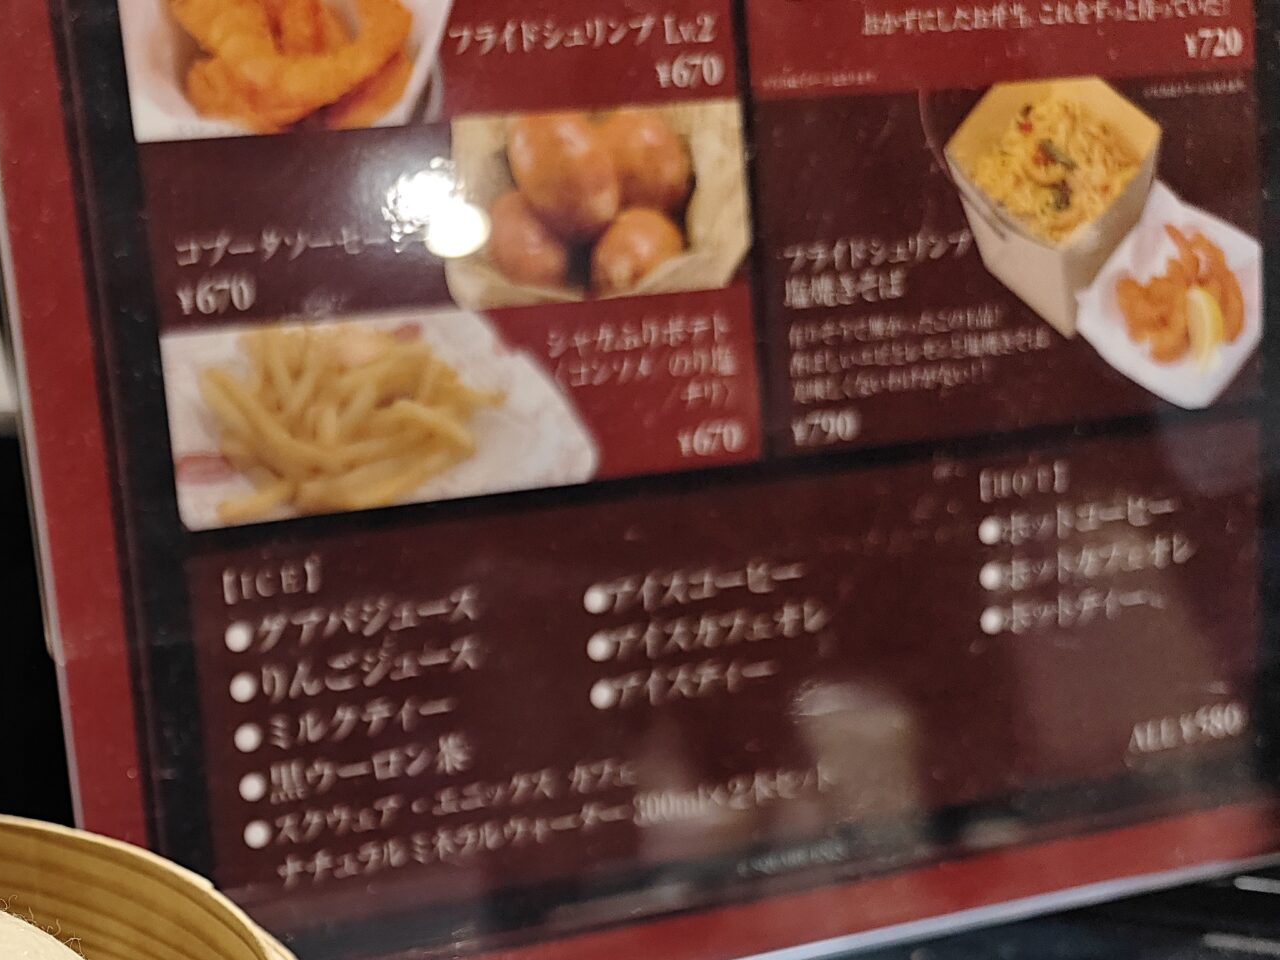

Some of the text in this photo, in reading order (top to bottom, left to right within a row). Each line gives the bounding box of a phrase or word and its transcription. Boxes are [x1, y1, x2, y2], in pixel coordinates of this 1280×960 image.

[448, 13, 656, 55] フライドシュリンプ
[1184, 26, 1244, 58] ¥720
[655, 52, 724, 88] ¥670
[176, 272, 257, 315] ¥670
[677, 418, 744, 457] ¥670
[791, 406, 861, 446] ¥790
[1003, 496, 1176, 545] ホットコーヒー
[612, 558, 804, 613] アイスコーヒー
[1004, 532, 1196, 591] ホットカフェオレ
[256, 584, 480, 654] グアバジュース
[615, 597, 829, 661] アイスカフェオレ
[260, 633, 481, 702] りんごジュース
[618, 657, 780, 708] アイスティー
[268, 698, 455, 750] ミルクティー
[270, 731, 475, 803] 黒ウーロン茶
[275, 768, 555, 843] スクウェア・エニックス
